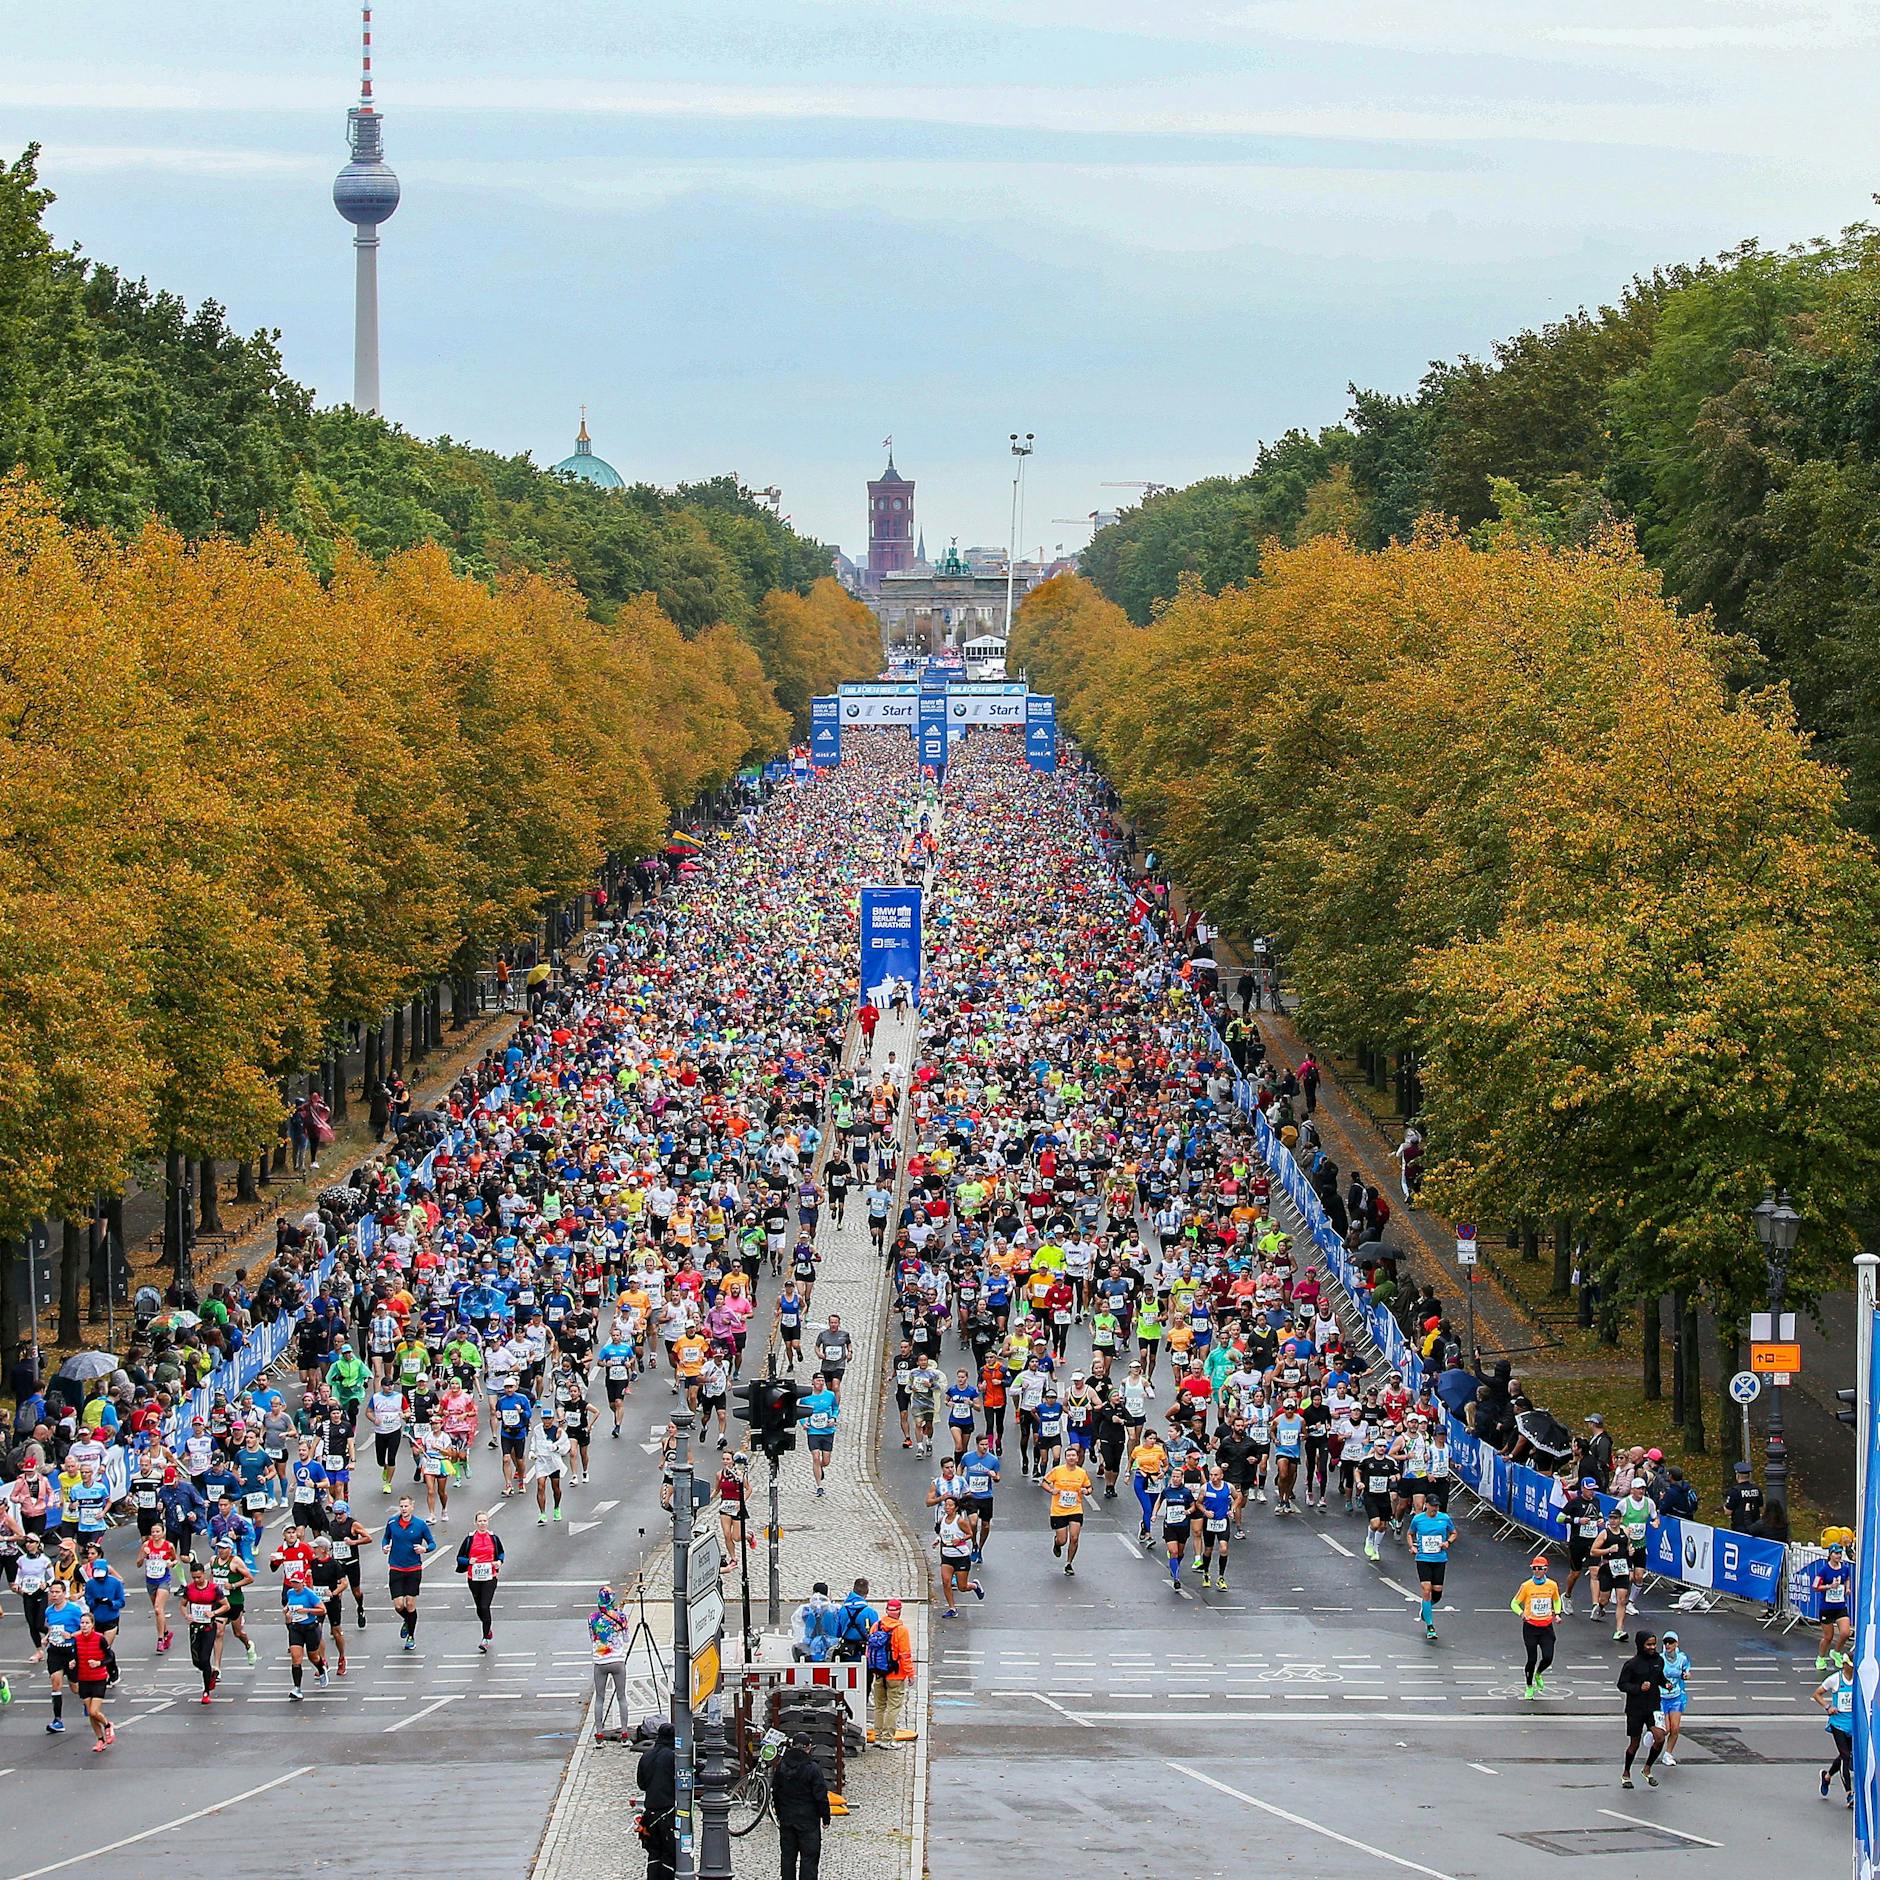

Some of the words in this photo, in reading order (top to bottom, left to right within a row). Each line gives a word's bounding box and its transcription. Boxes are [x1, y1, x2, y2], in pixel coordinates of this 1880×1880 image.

[882, 705, 912, 716] Start
[989, 704, 1020, 715] Start
[872, 907, 897, 916] BMW
[1741, 1489, 1760, 1498] POLIZEI
